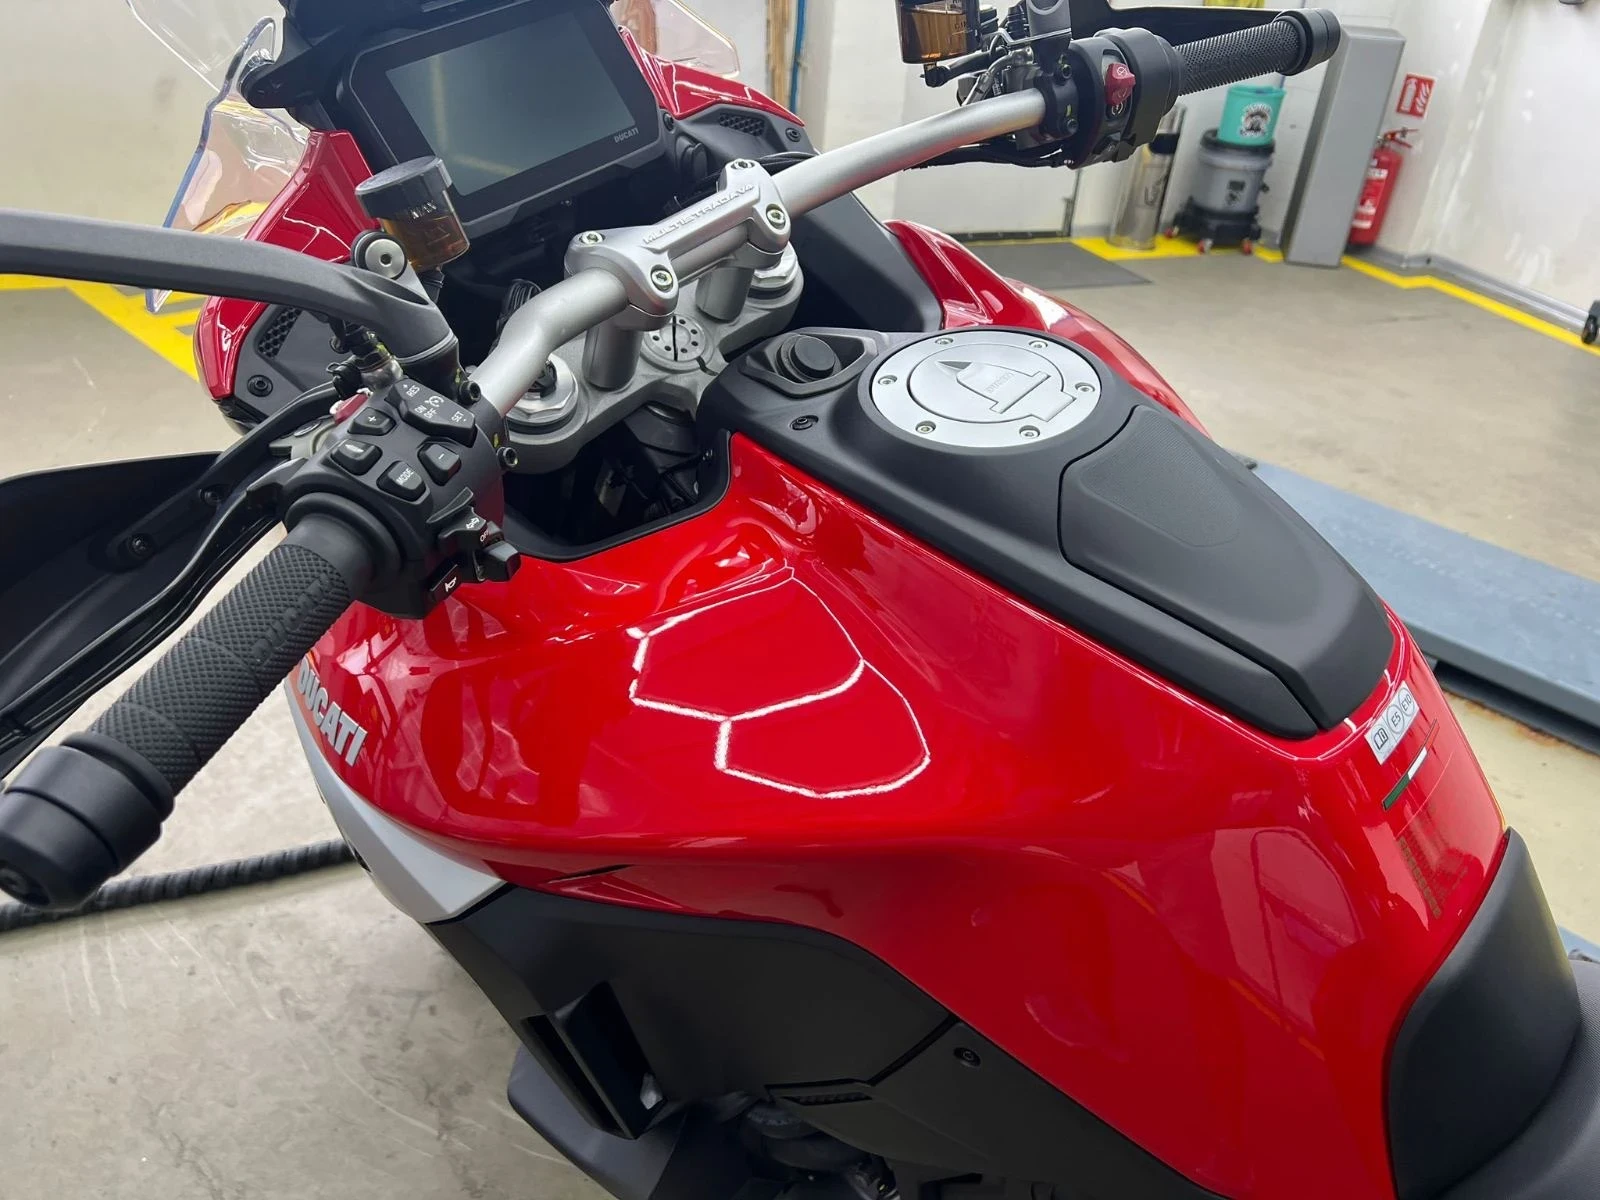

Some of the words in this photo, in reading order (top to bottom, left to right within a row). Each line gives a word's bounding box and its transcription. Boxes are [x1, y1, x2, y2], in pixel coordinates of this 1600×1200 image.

[613, 127, 639, 143] DUCATI
[406, 384, 420, 398] RES
[414, 404, 428, 414] ON
[423, 407, 438, 419] OFF
[451, 410, 465, 423] SET
[395, 467, 415, 486] MODE
[297, 656, 368, 768] DUCATI
[1391, 711, 1401, 727] E5
[1401, 693, 1412, 712] E10
